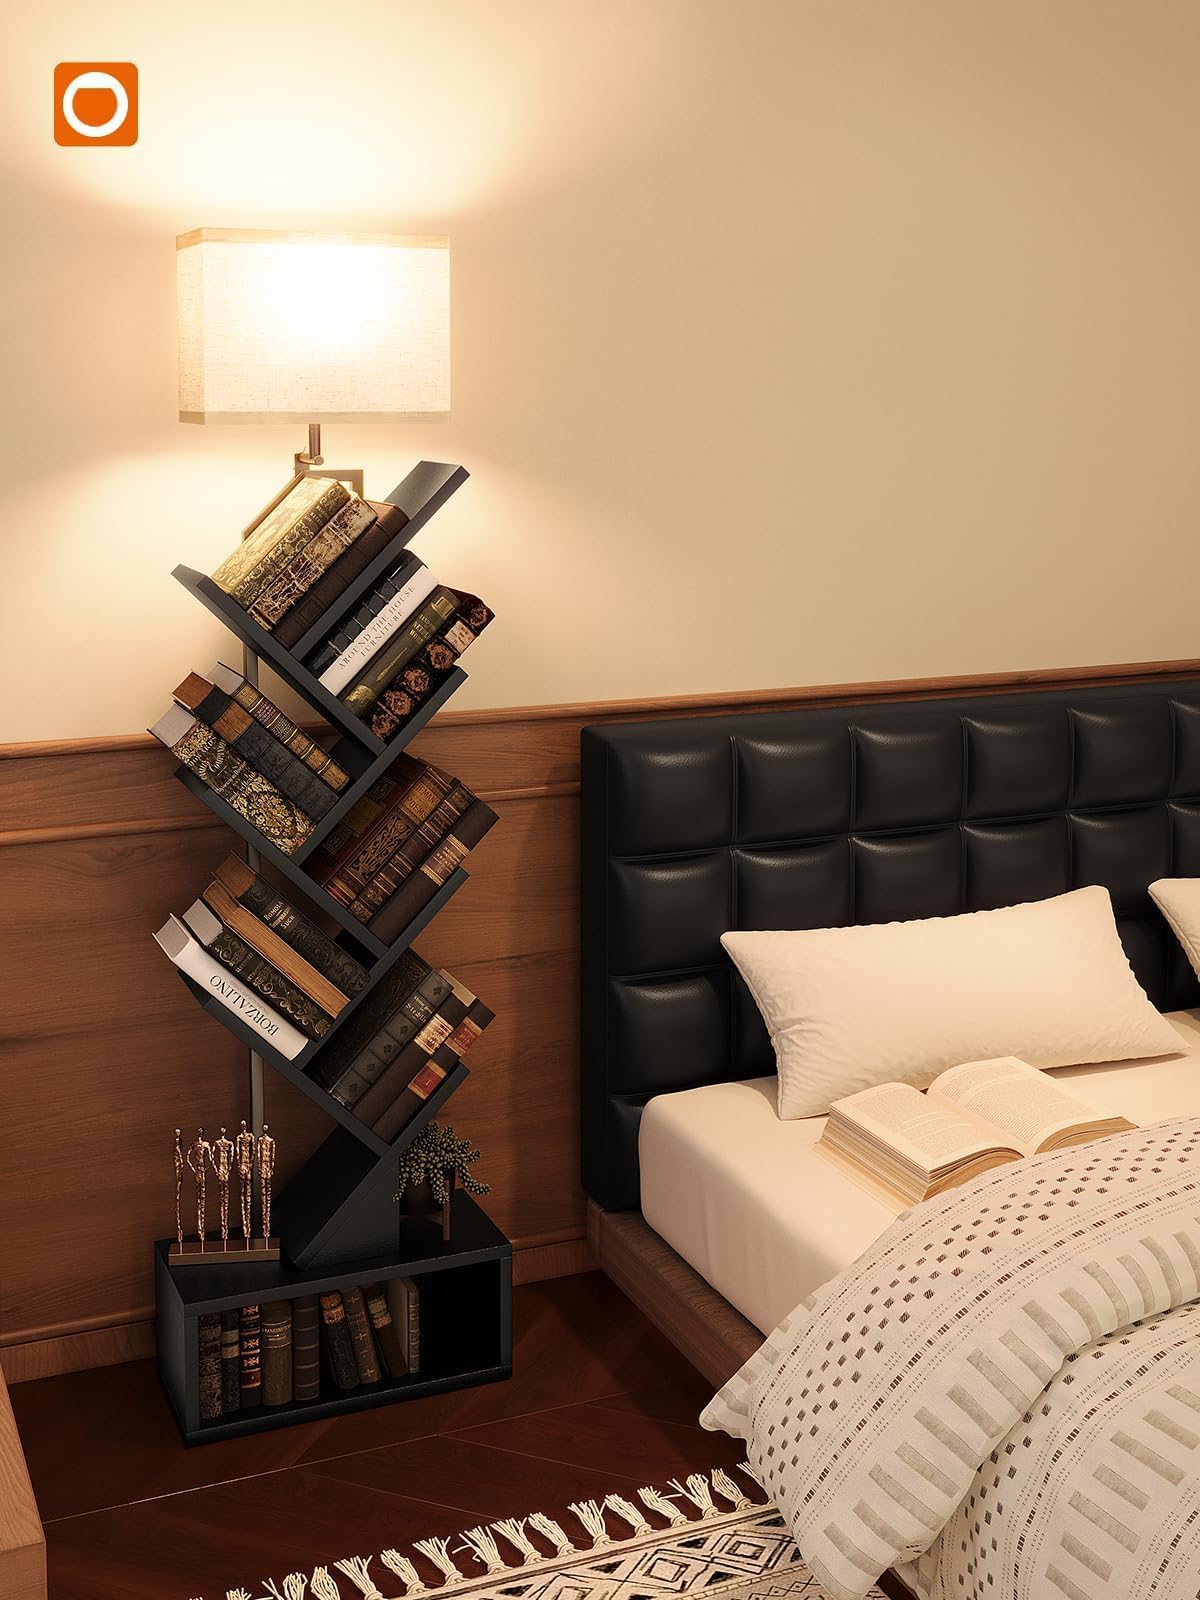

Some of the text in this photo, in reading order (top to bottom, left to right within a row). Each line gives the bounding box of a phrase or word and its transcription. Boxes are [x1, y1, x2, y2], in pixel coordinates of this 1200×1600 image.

[338, 585, 416, 670] AROUND THE HOUSE
[360, 610, 405, 657] FURNITURE
[404, 795, 428, 818] POEMS
[209, 975, 280, 1037] BORZALINO
